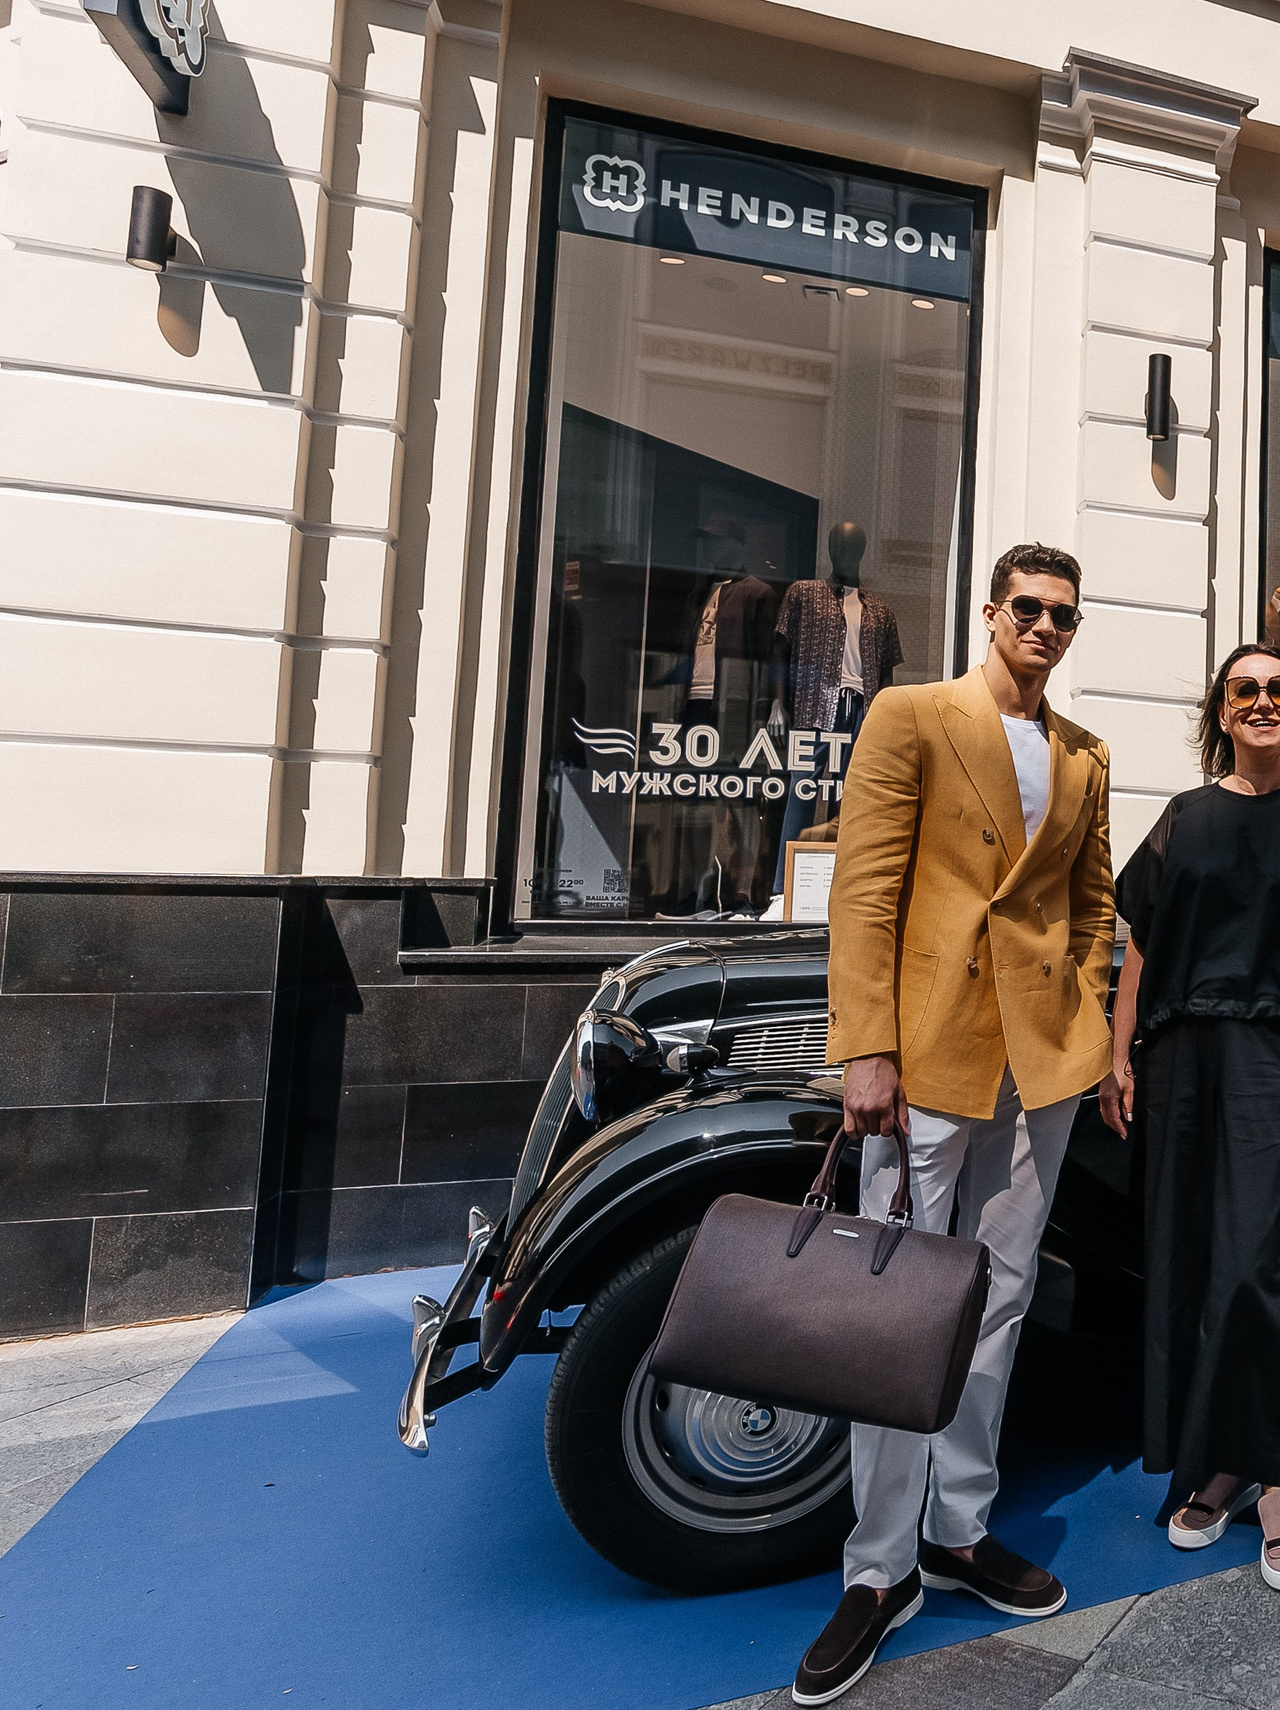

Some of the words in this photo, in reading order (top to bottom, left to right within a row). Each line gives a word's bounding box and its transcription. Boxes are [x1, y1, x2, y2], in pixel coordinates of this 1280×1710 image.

[602, 171, 628, 197] H
[660, 180, 958, 261] HENDERSON
[649, 722, 720, 767] 30
[739, 728, 852, 773] ЛЕТ
[591, 770, 785, 799] МУЖСКОГО
